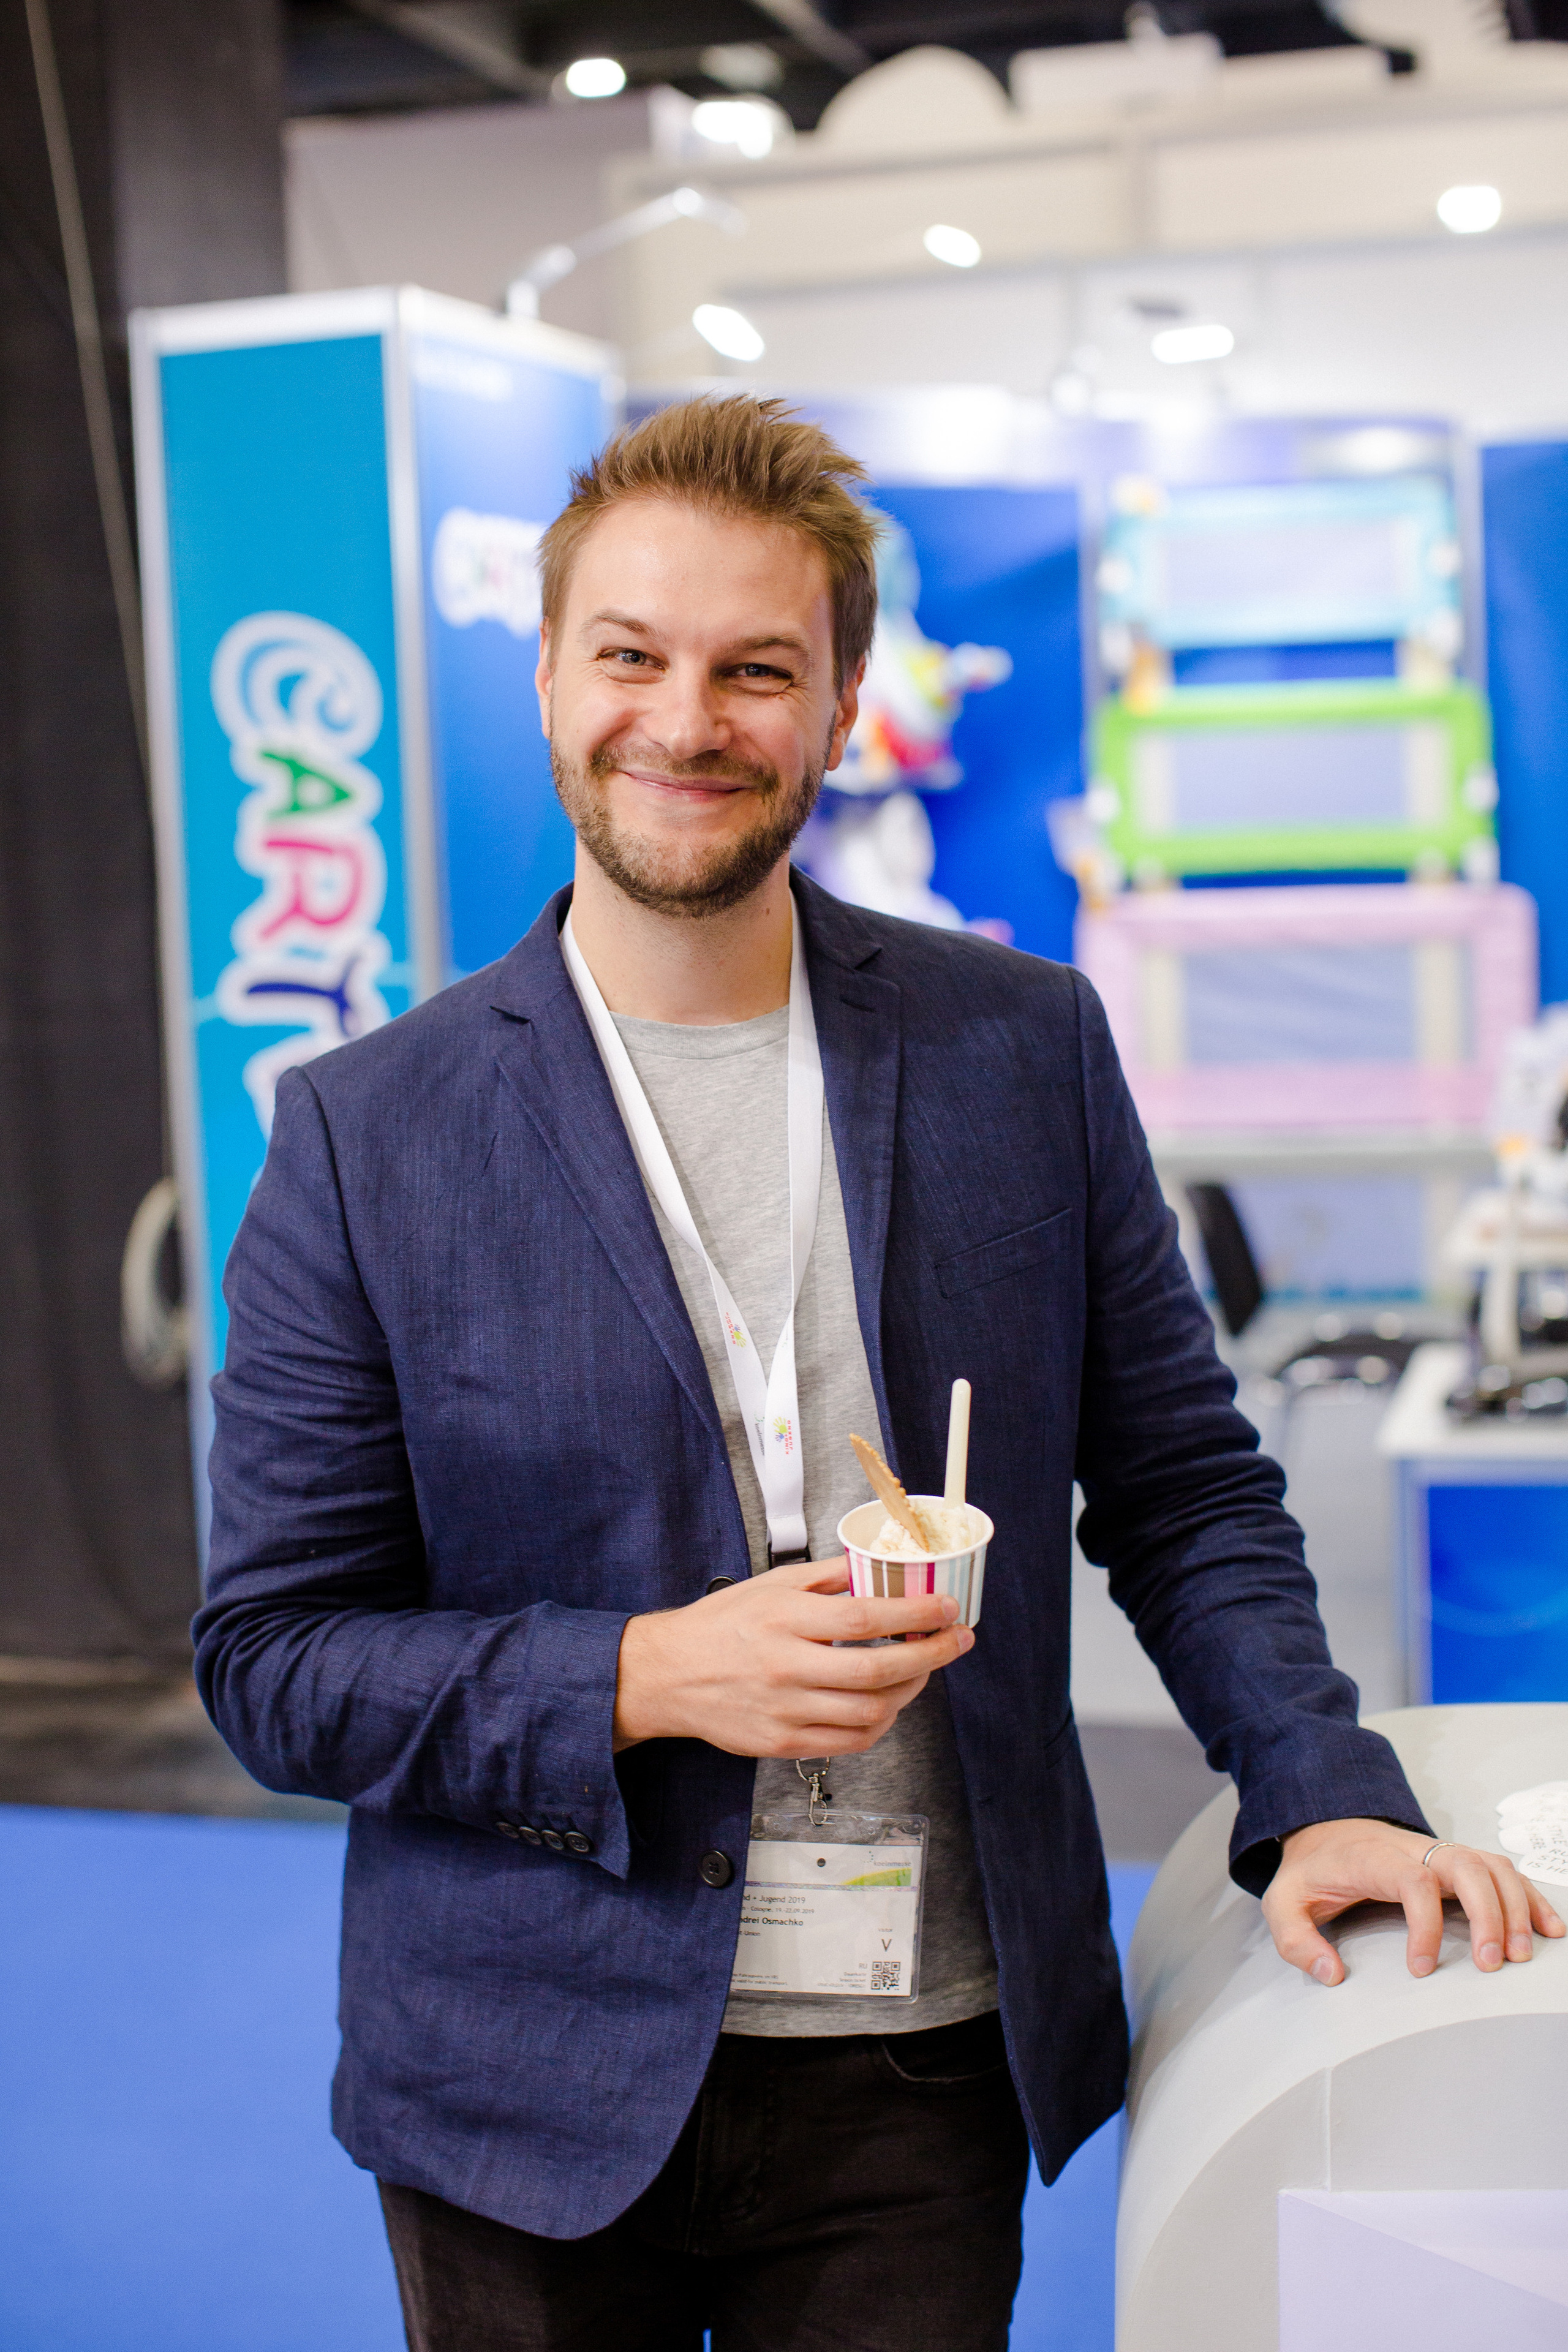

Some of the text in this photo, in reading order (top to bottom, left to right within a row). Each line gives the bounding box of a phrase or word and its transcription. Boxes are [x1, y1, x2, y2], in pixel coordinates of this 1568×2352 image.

[759, 1895, 786, 1904] Jugend
[762, 1917, 804, 1926] Osmachko
[881, 1939, 892, 1952] V
